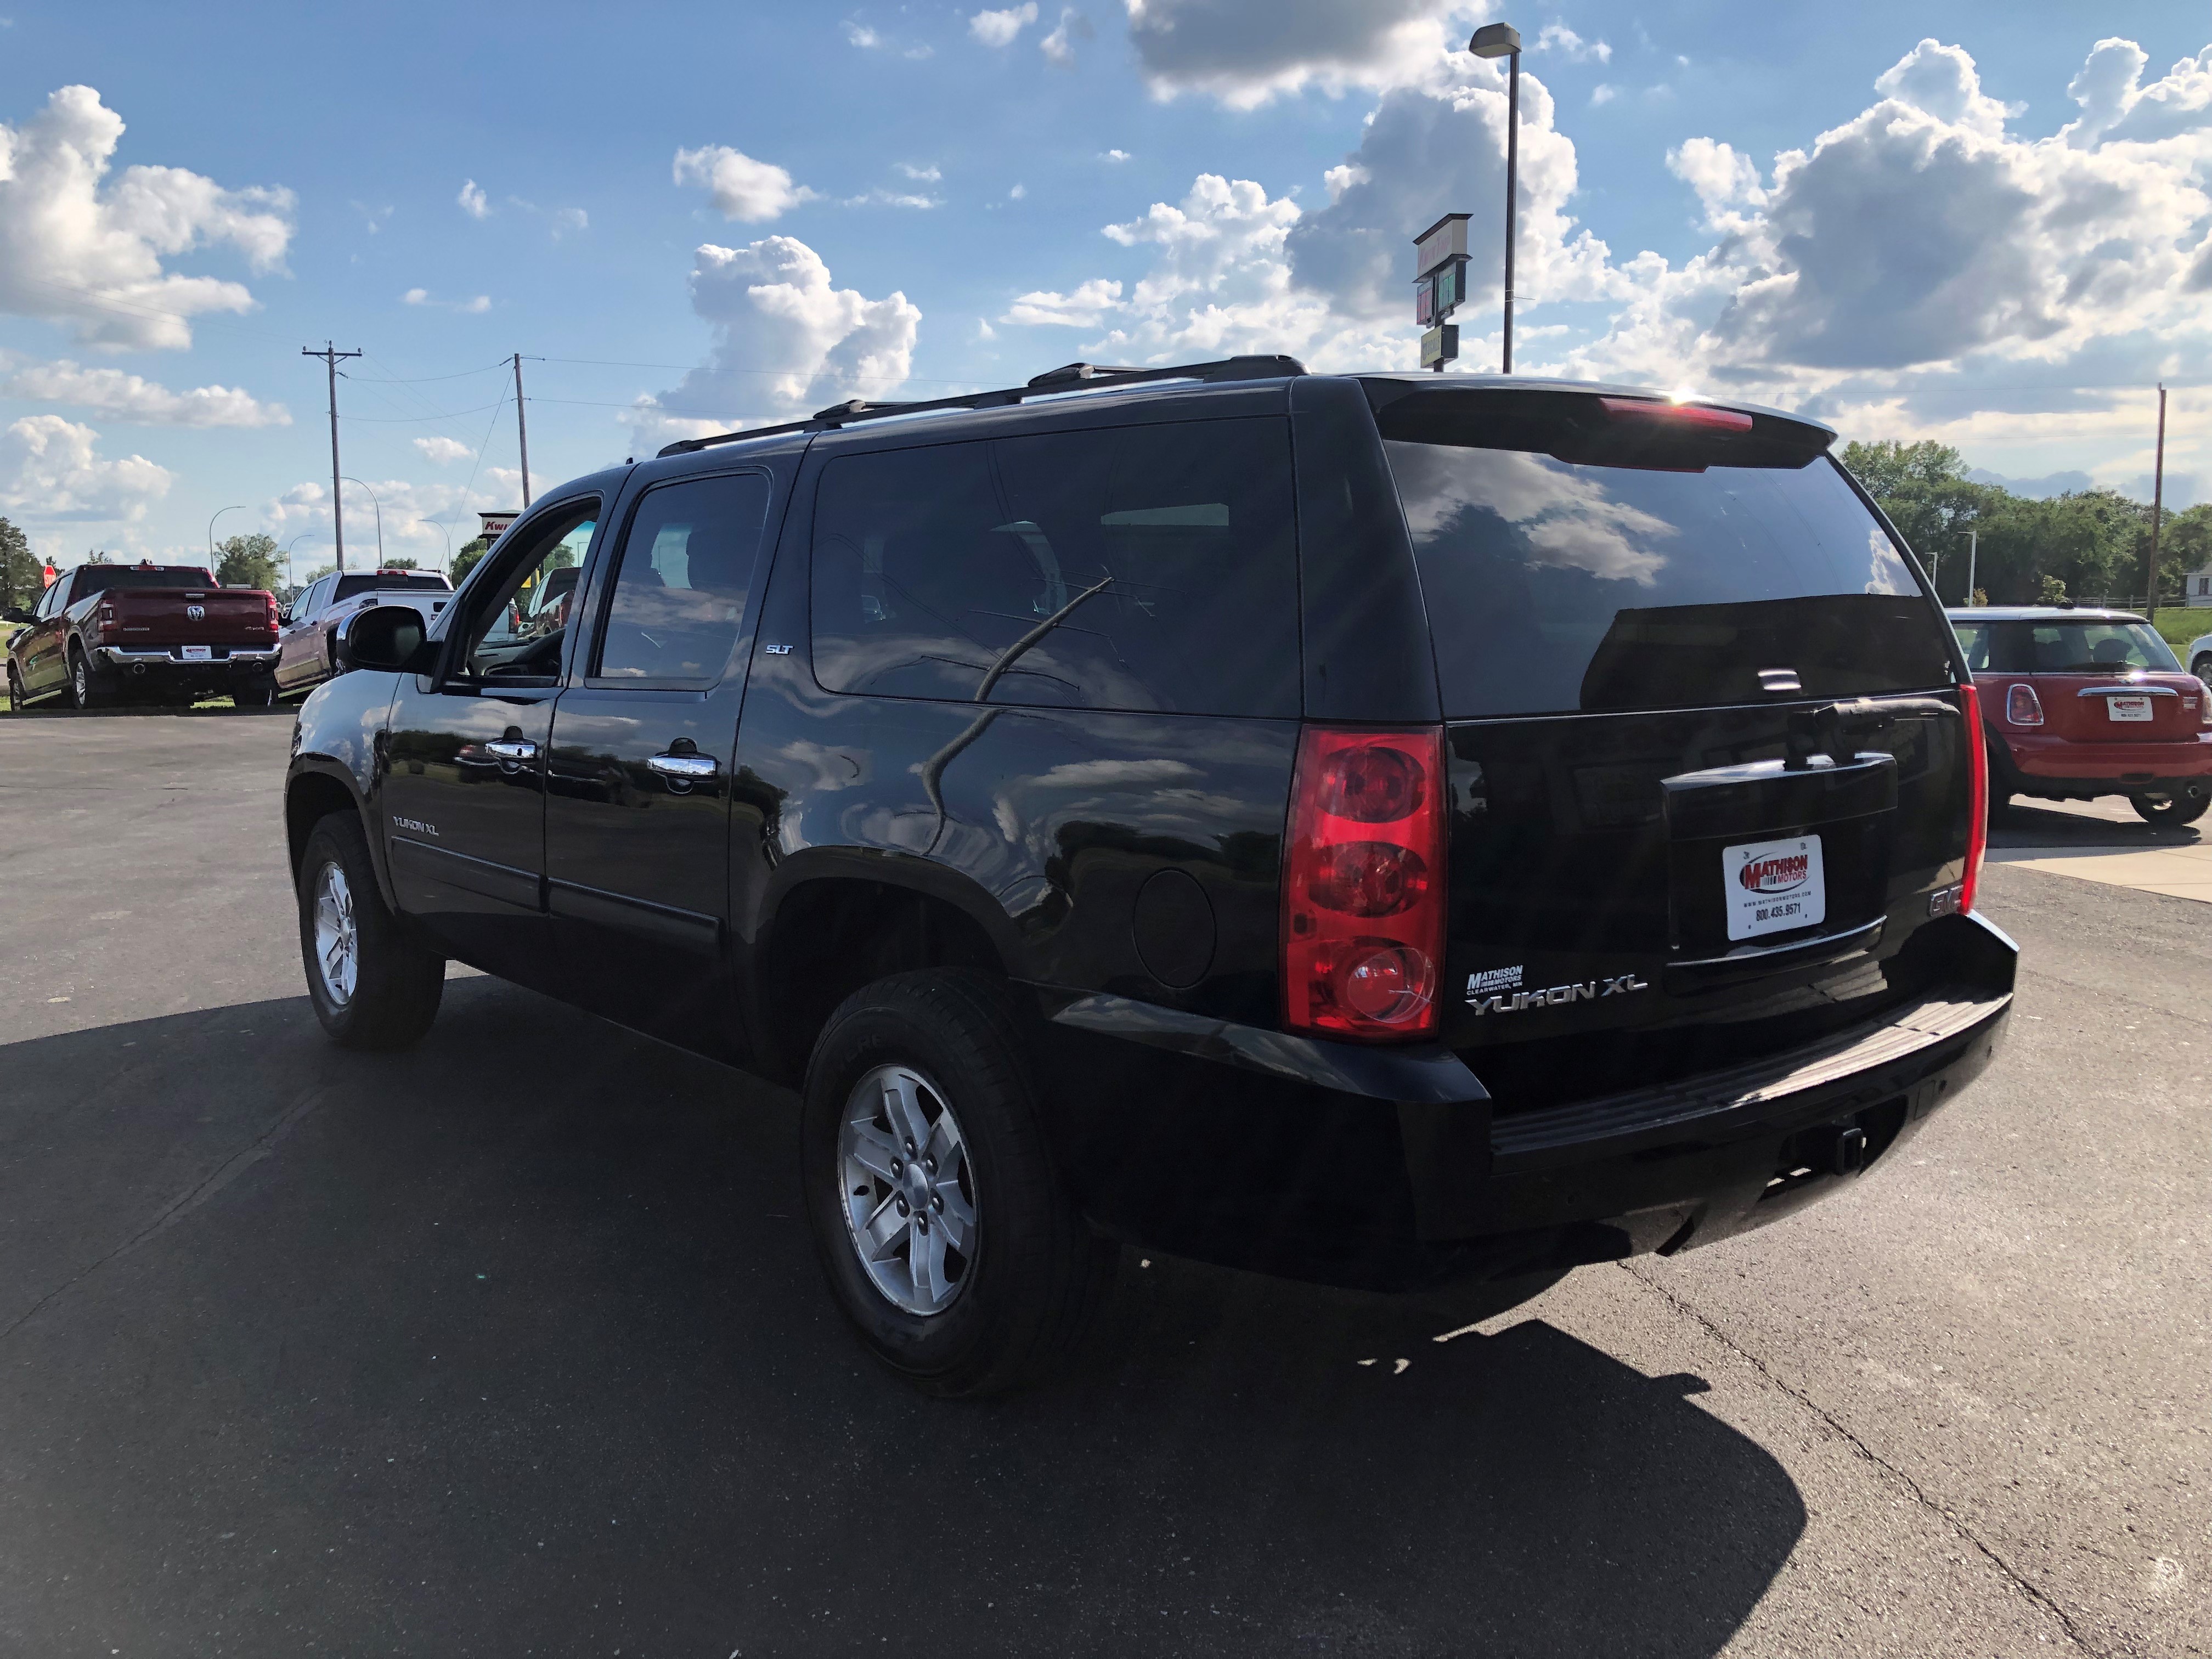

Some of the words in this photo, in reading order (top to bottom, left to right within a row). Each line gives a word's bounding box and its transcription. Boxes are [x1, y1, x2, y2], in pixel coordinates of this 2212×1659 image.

[765, 645, 793, 654] SLT
[393, 816, 425, 833] YUKON
[425, 823, 439, 836] XL
[1745, 854, 1808, 890] MATHISON
[1778, 870, 1807, 883] MOTORS
[1756, 902, 1801, 921] 800.435.9571
[1466, 964, 1523, 990] MATHISON
[1494, 974, 1522, 985] MOTORS
[1464, 981, 1596, 1016] YUKON
[1600, 974, 1649, 997] XL
[1466, 984, 1511, 996] CLEARWATER,
